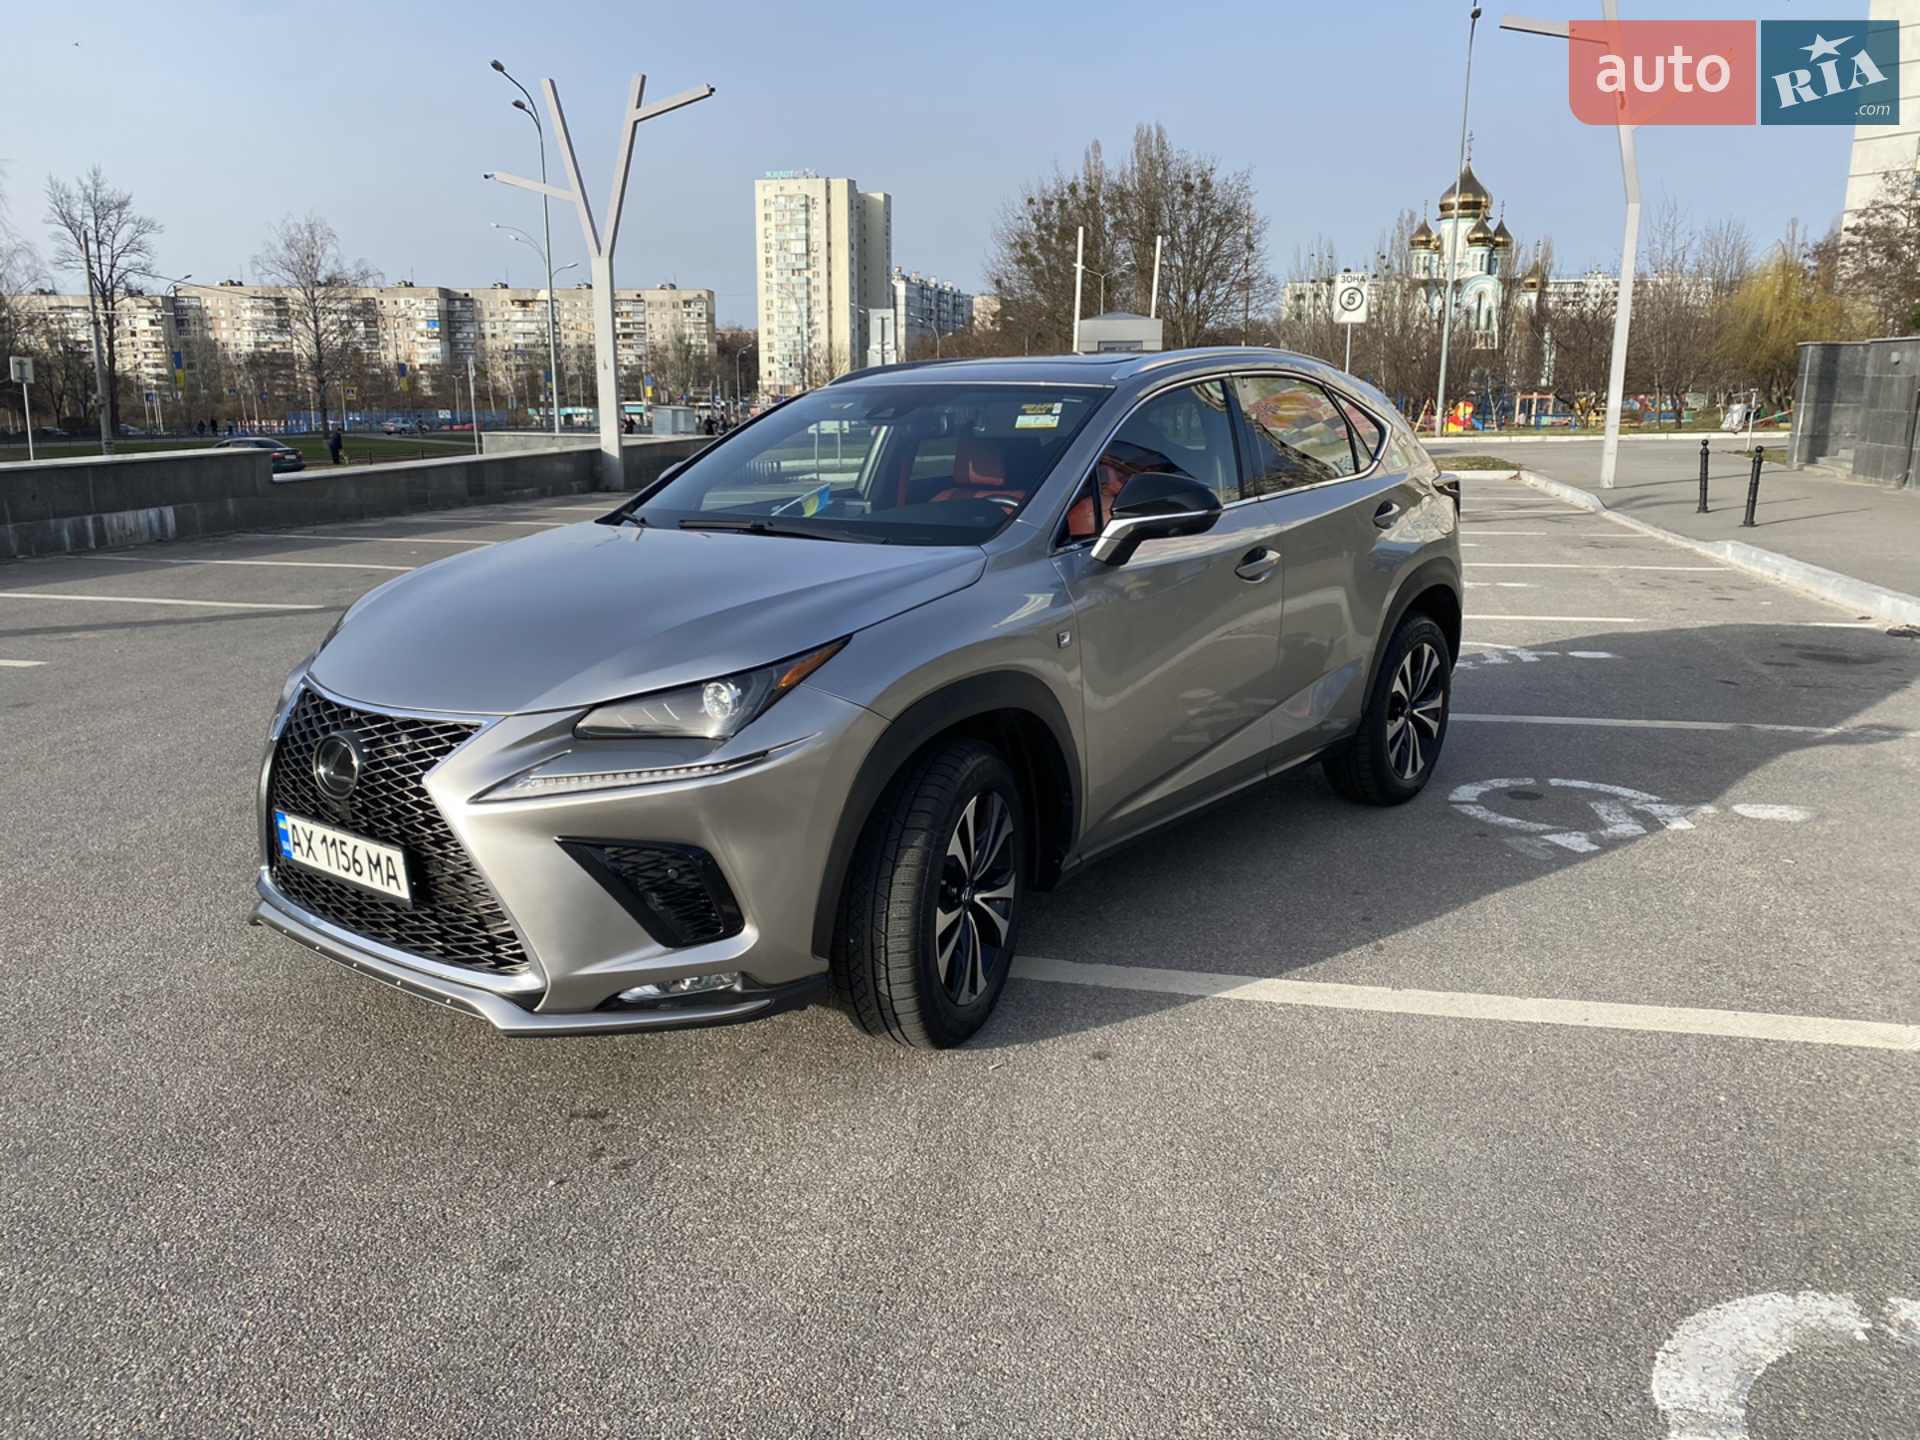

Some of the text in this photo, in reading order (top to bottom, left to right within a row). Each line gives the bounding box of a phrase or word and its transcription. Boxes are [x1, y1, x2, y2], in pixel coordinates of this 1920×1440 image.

[1340, 275, 1366, 284] ЗОНА
[1346, 292, 1356, 306] 5
[291, 823, 402, 891] AX 1156 MA
